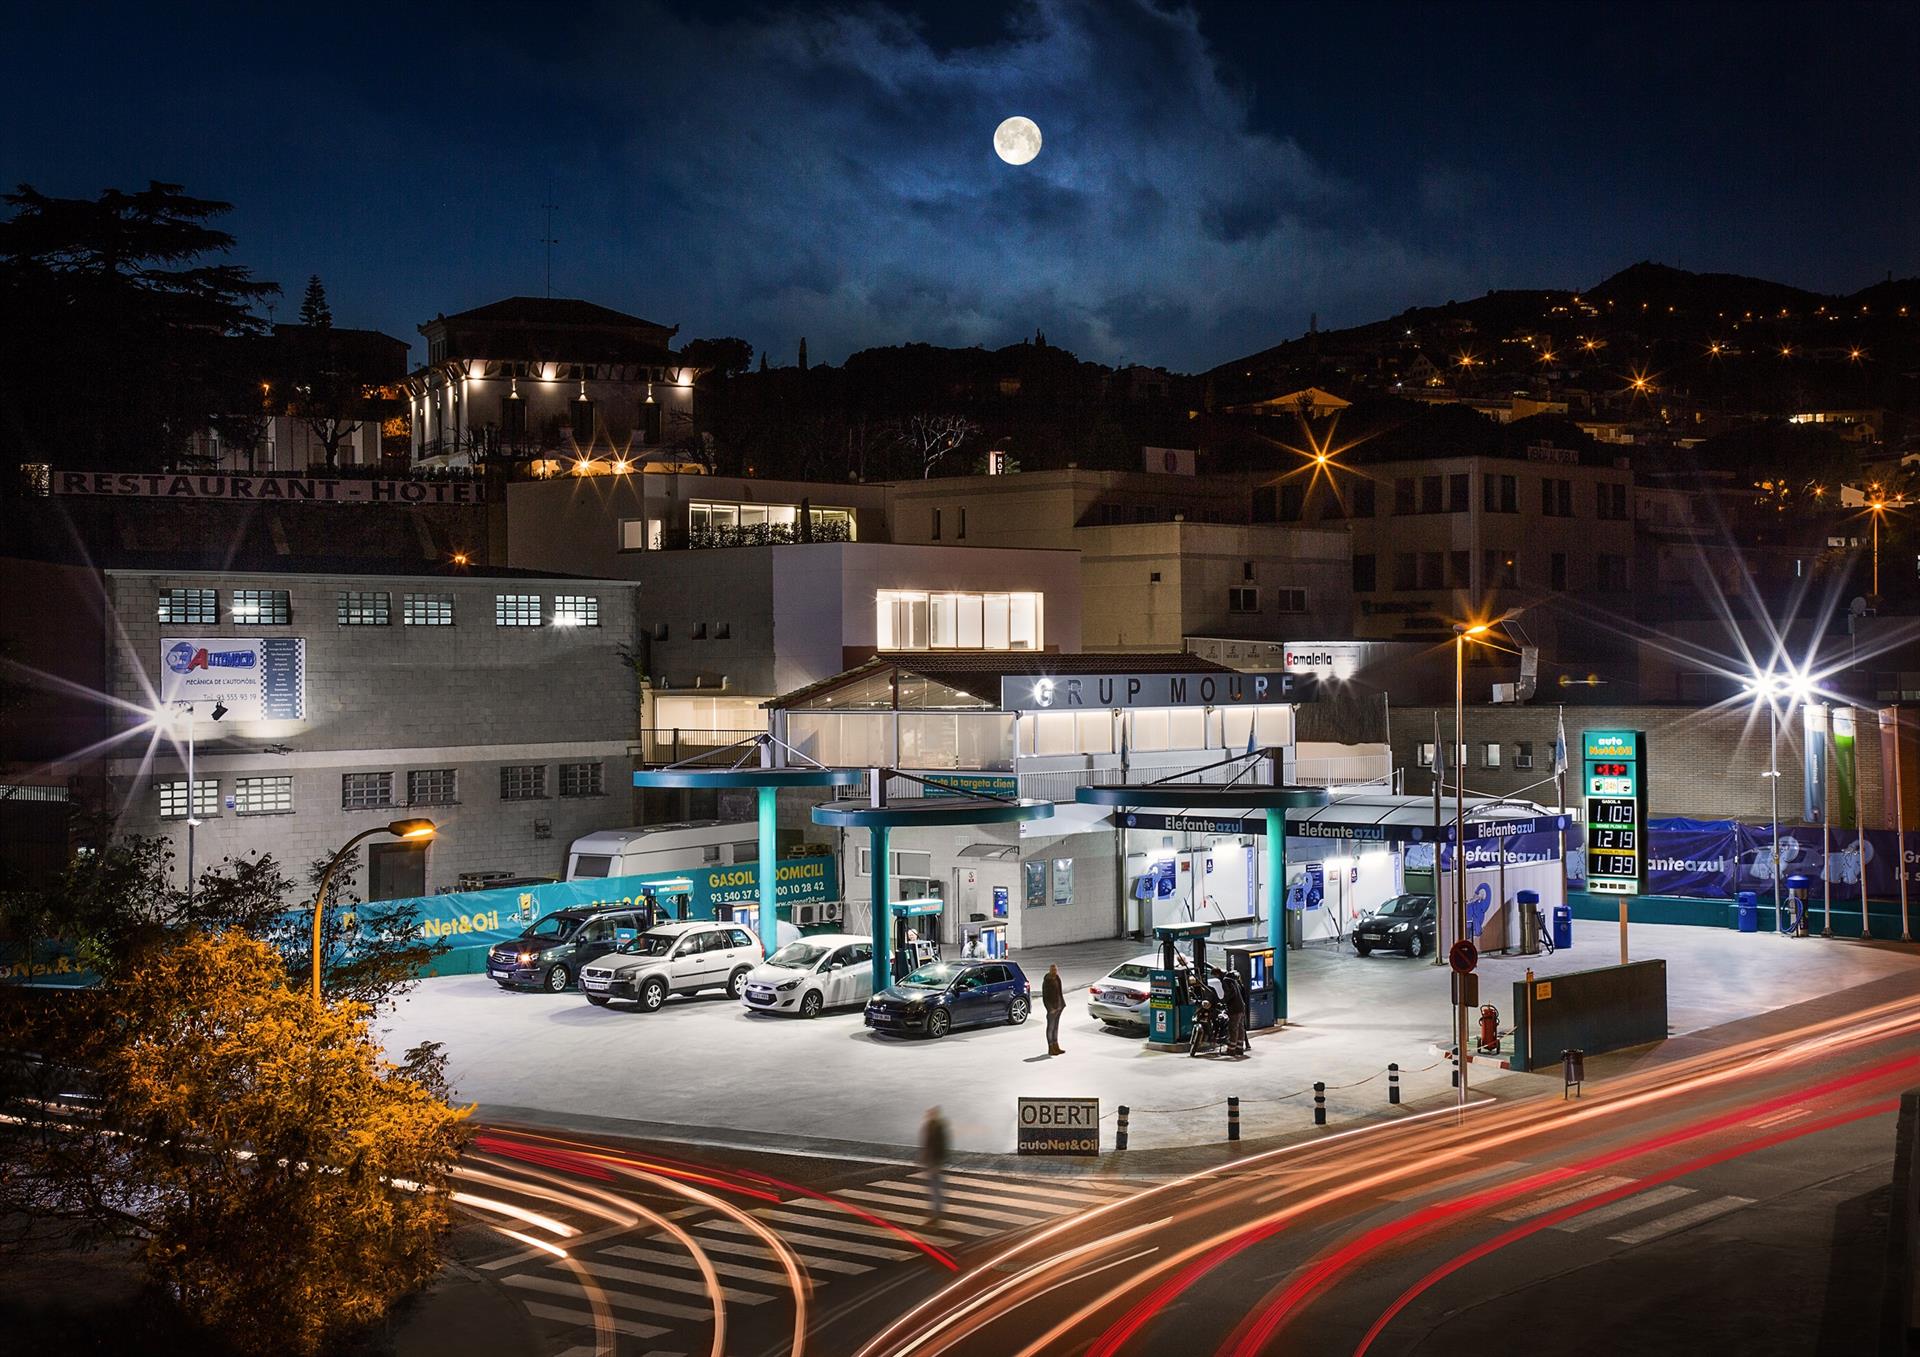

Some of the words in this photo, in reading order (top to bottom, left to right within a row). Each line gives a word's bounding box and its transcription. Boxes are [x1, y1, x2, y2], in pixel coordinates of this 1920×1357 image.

[62, 472, 339, 500] RESTAURANT
[1286, 652, 1333, 666] Comalella
[1034, 677, 1141, 708] GRUP
[1598, 736, 1623, 746] auto
[960, 778, 991, 789] targeta
[992, 777, 1015, 789] client
[1597, 805, 1633, 823] 1.109
[1165, 817, 1243, 833] Elefanteazul
[1299, 819, 1385, 840] Elefanteazul
[1478, 818, 1536, 838] Elefanteazul
[1597, 831, 1634, 849] 1.219
[1597, 856, 1634, 874] 1.139
[708, 871, 755, 888] GASOIL
[710, 893, 722, 903] 93
[724, 890, 741, 901] 540
[742, 889, 751, 900] 37
[790, 884, 800, 894] 10
[802, 882, 812, 893] 28
[813, 881, 825, 891] 42
[1021, 1104, 1097, 1125] OBERT
[1019, 1139, 1098, 1151] autoNet&Oil
